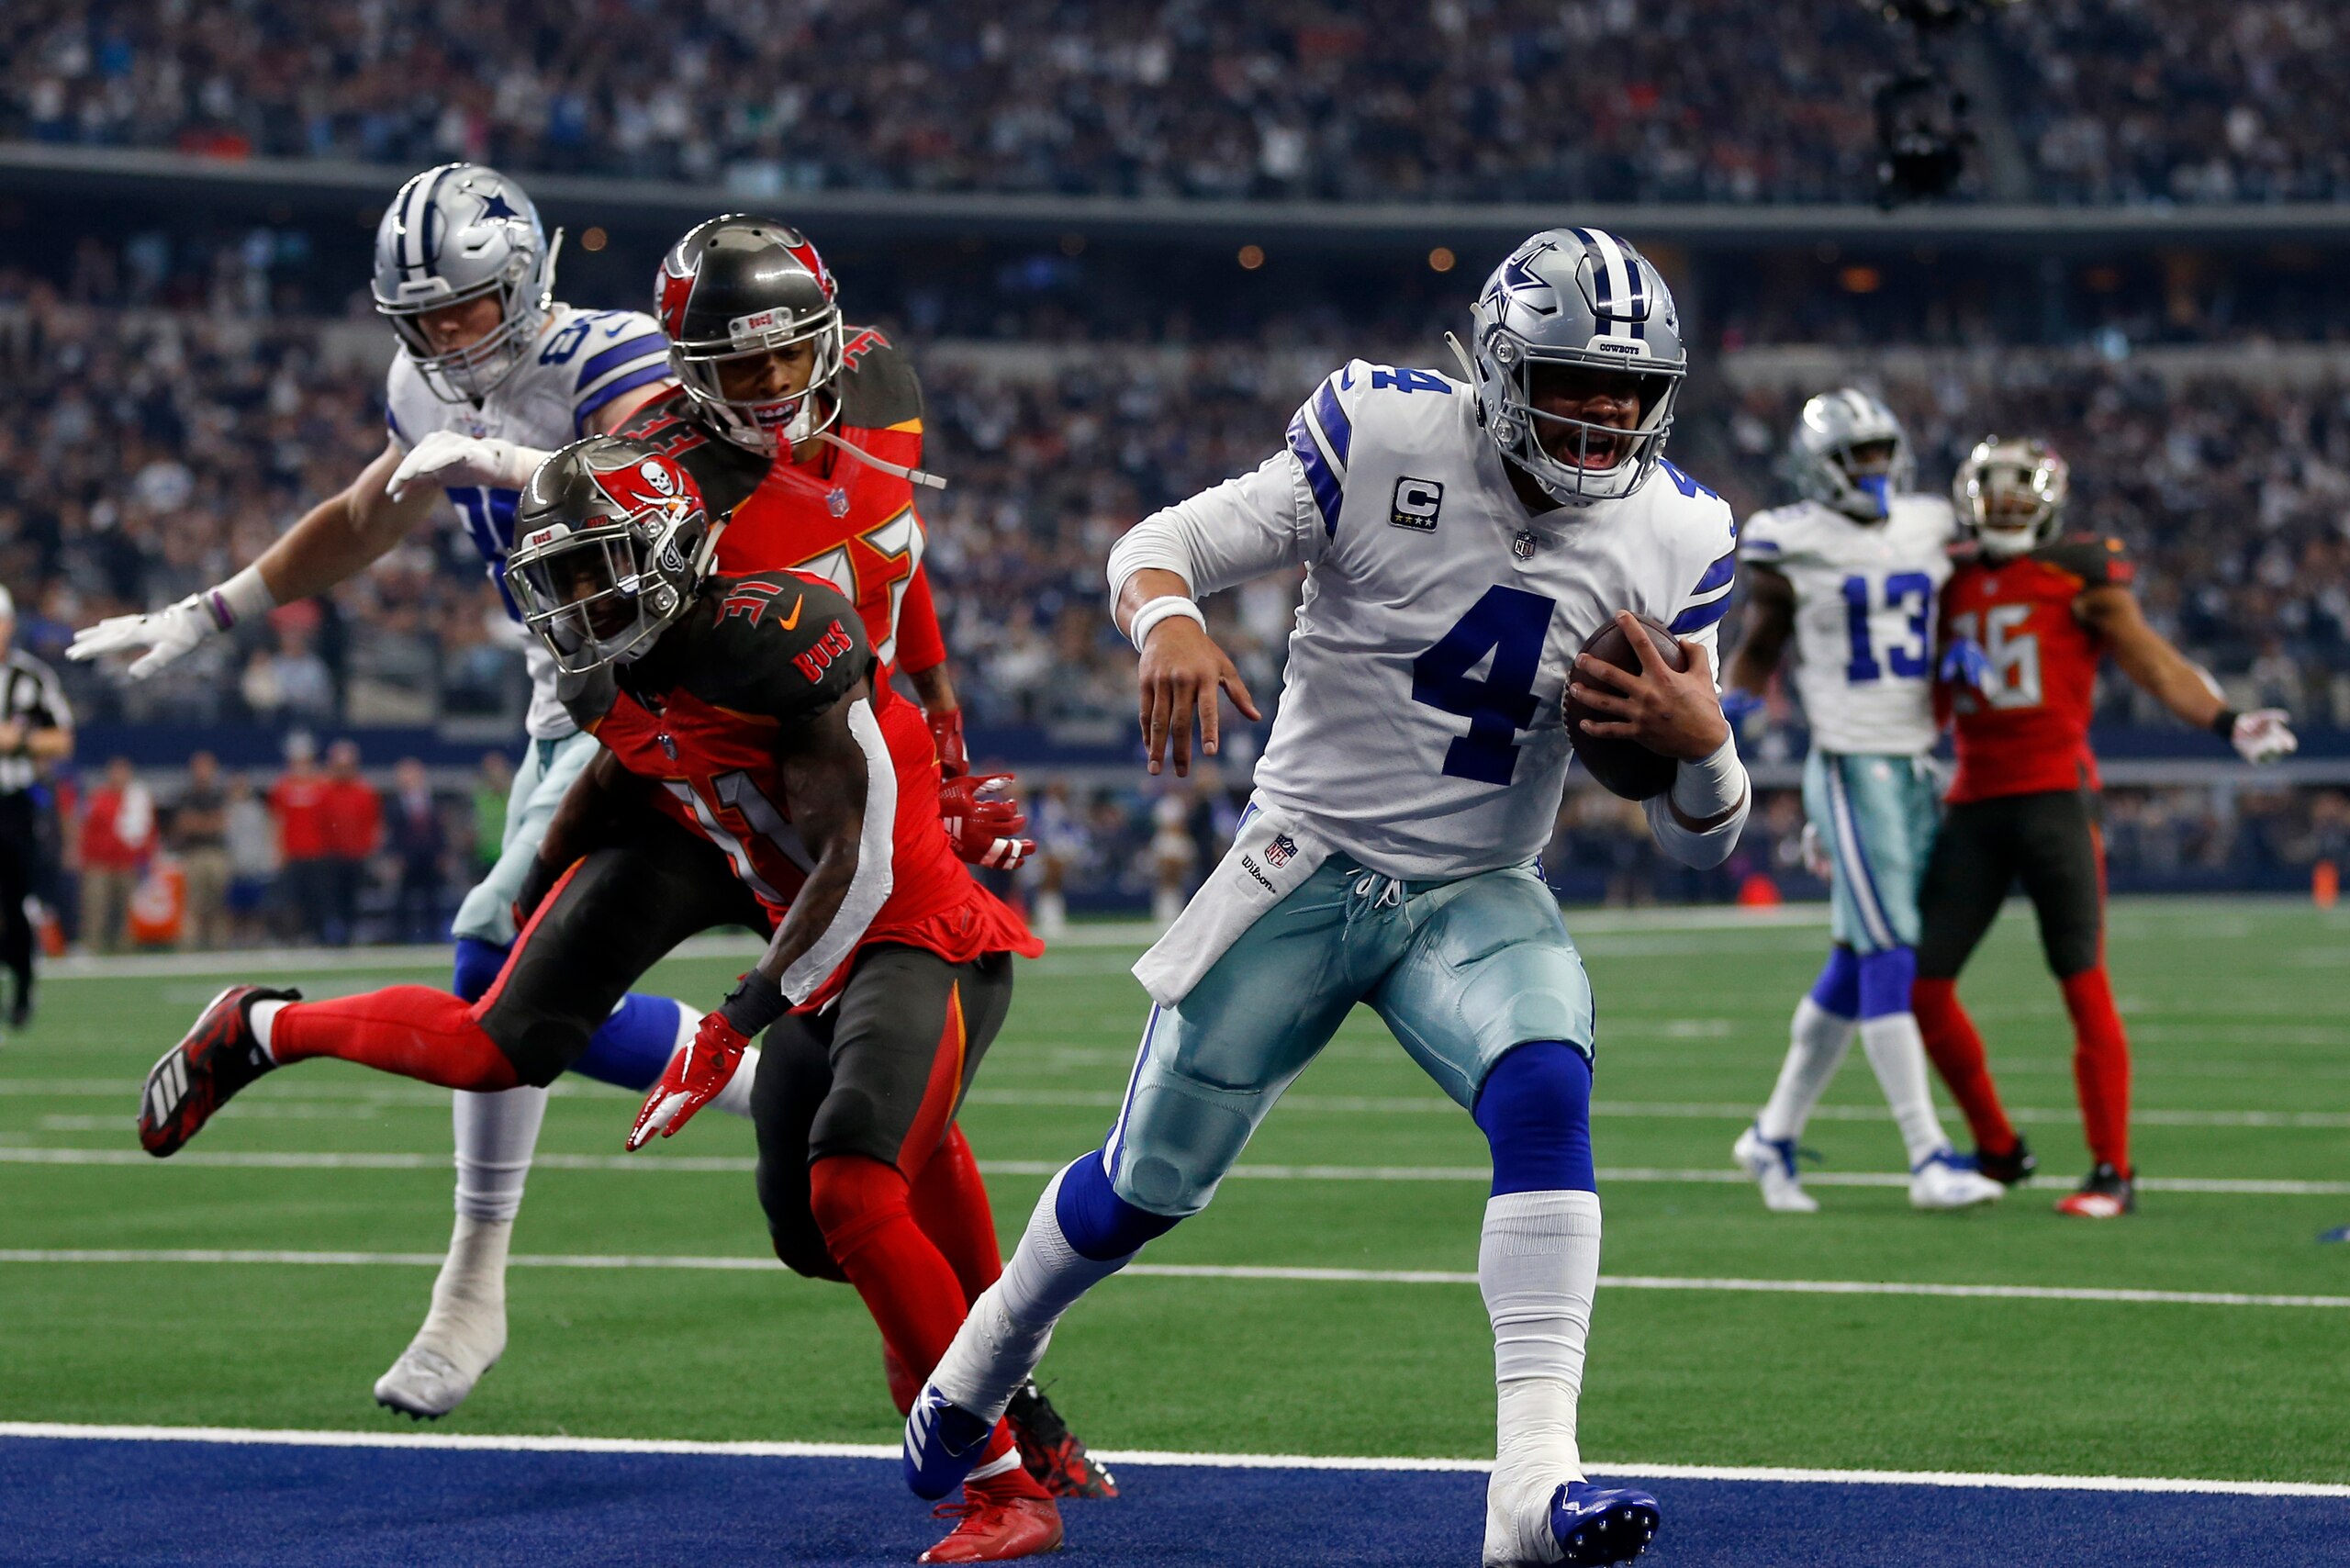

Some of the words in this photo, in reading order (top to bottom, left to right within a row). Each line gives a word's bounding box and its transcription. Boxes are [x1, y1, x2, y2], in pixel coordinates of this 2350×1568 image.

[1600, 343, 1639, 355] COWBOYS
[1371, 367, 1452, 394] 4
[1396, 480, 1440, 517] C
[1843, 572, 1934, 685] 13
[790, 619, 854, 685] BUCS
[1412, 584, 1557, 787] 4
[1241, 854, 1276, 894] Wilson
